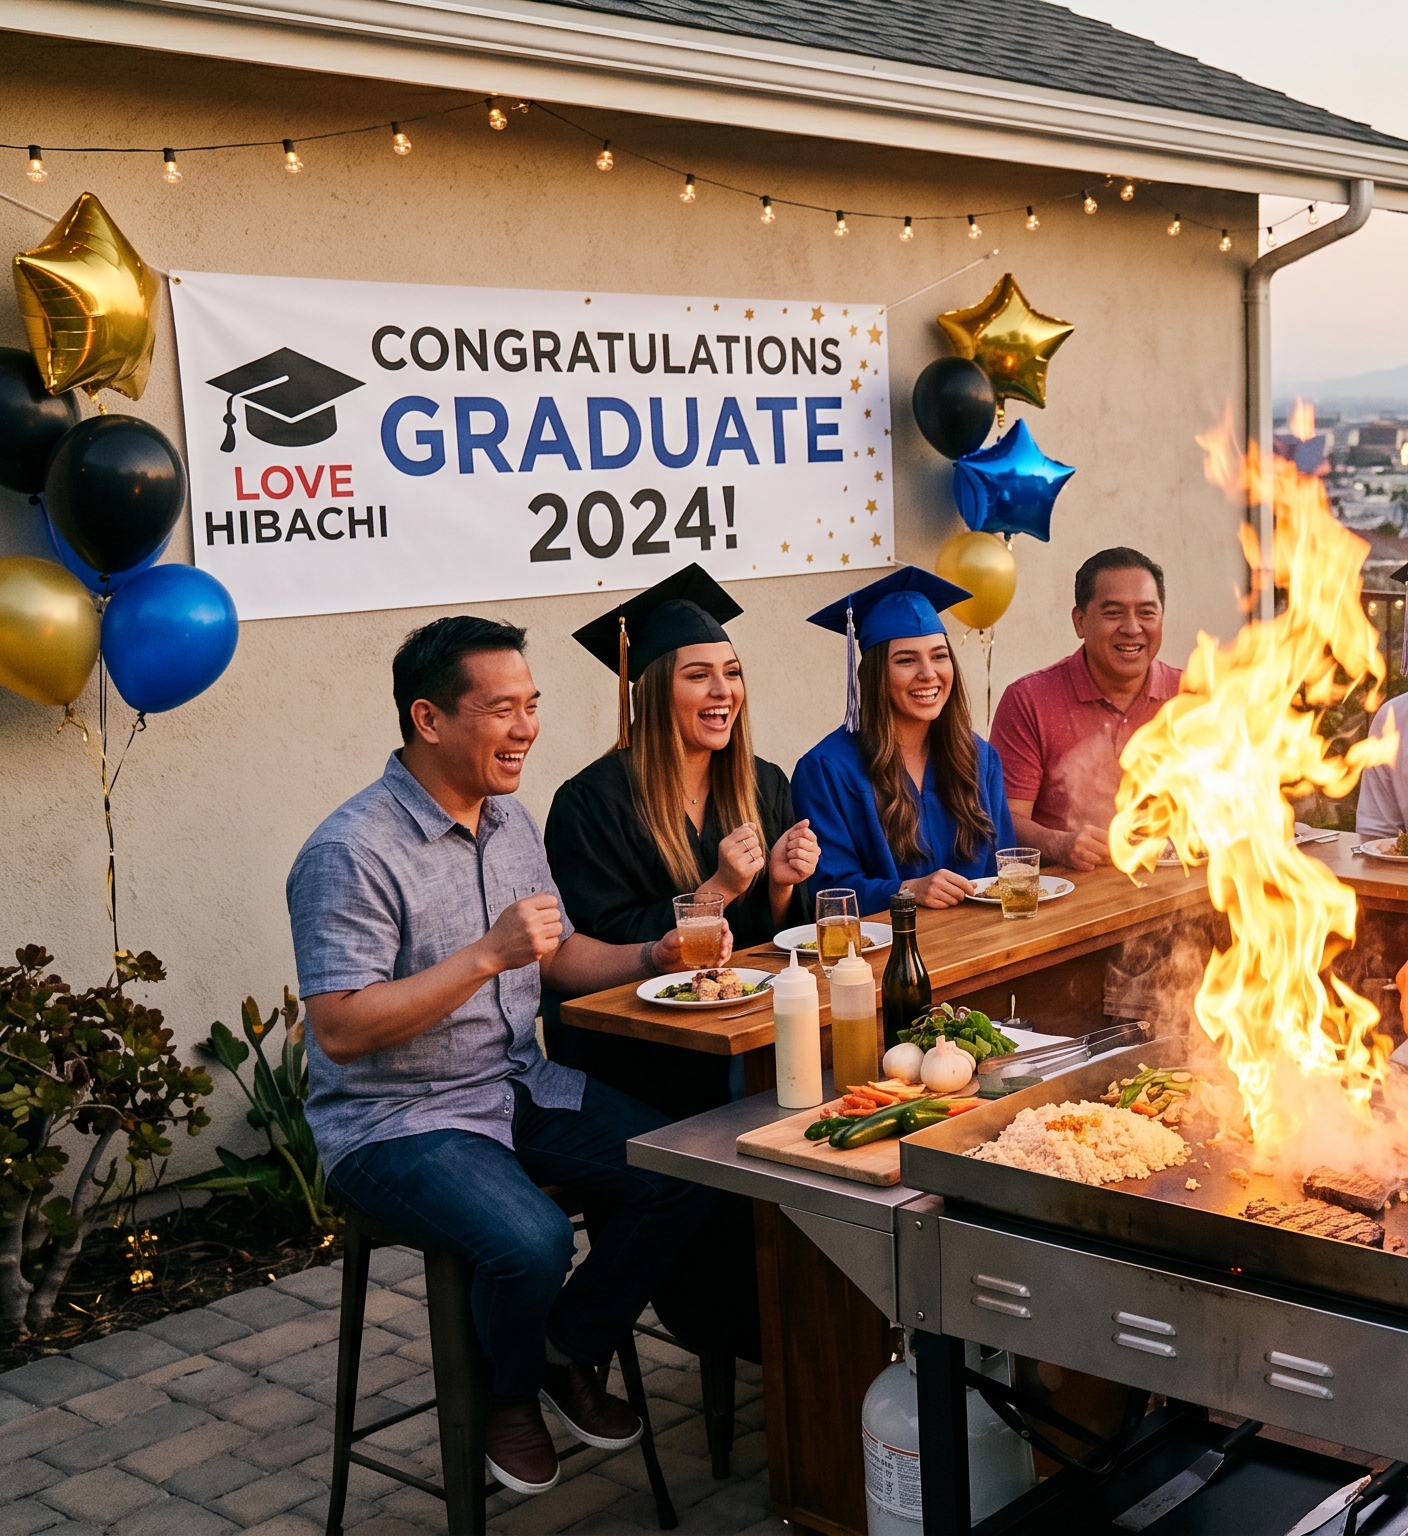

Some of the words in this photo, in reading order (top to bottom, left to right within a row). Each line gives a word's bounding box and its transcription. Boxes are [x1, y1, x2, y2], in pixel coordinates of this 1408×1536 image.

[371, 325, 842, 376] CONGRATULATIONS
[380, 395, 844, 477] GRADUATE
[234, 464, 354, 501] LOVE
[205, 505, 388, 546] HIBACHI
[527, 485, 738, 563] 2024!
